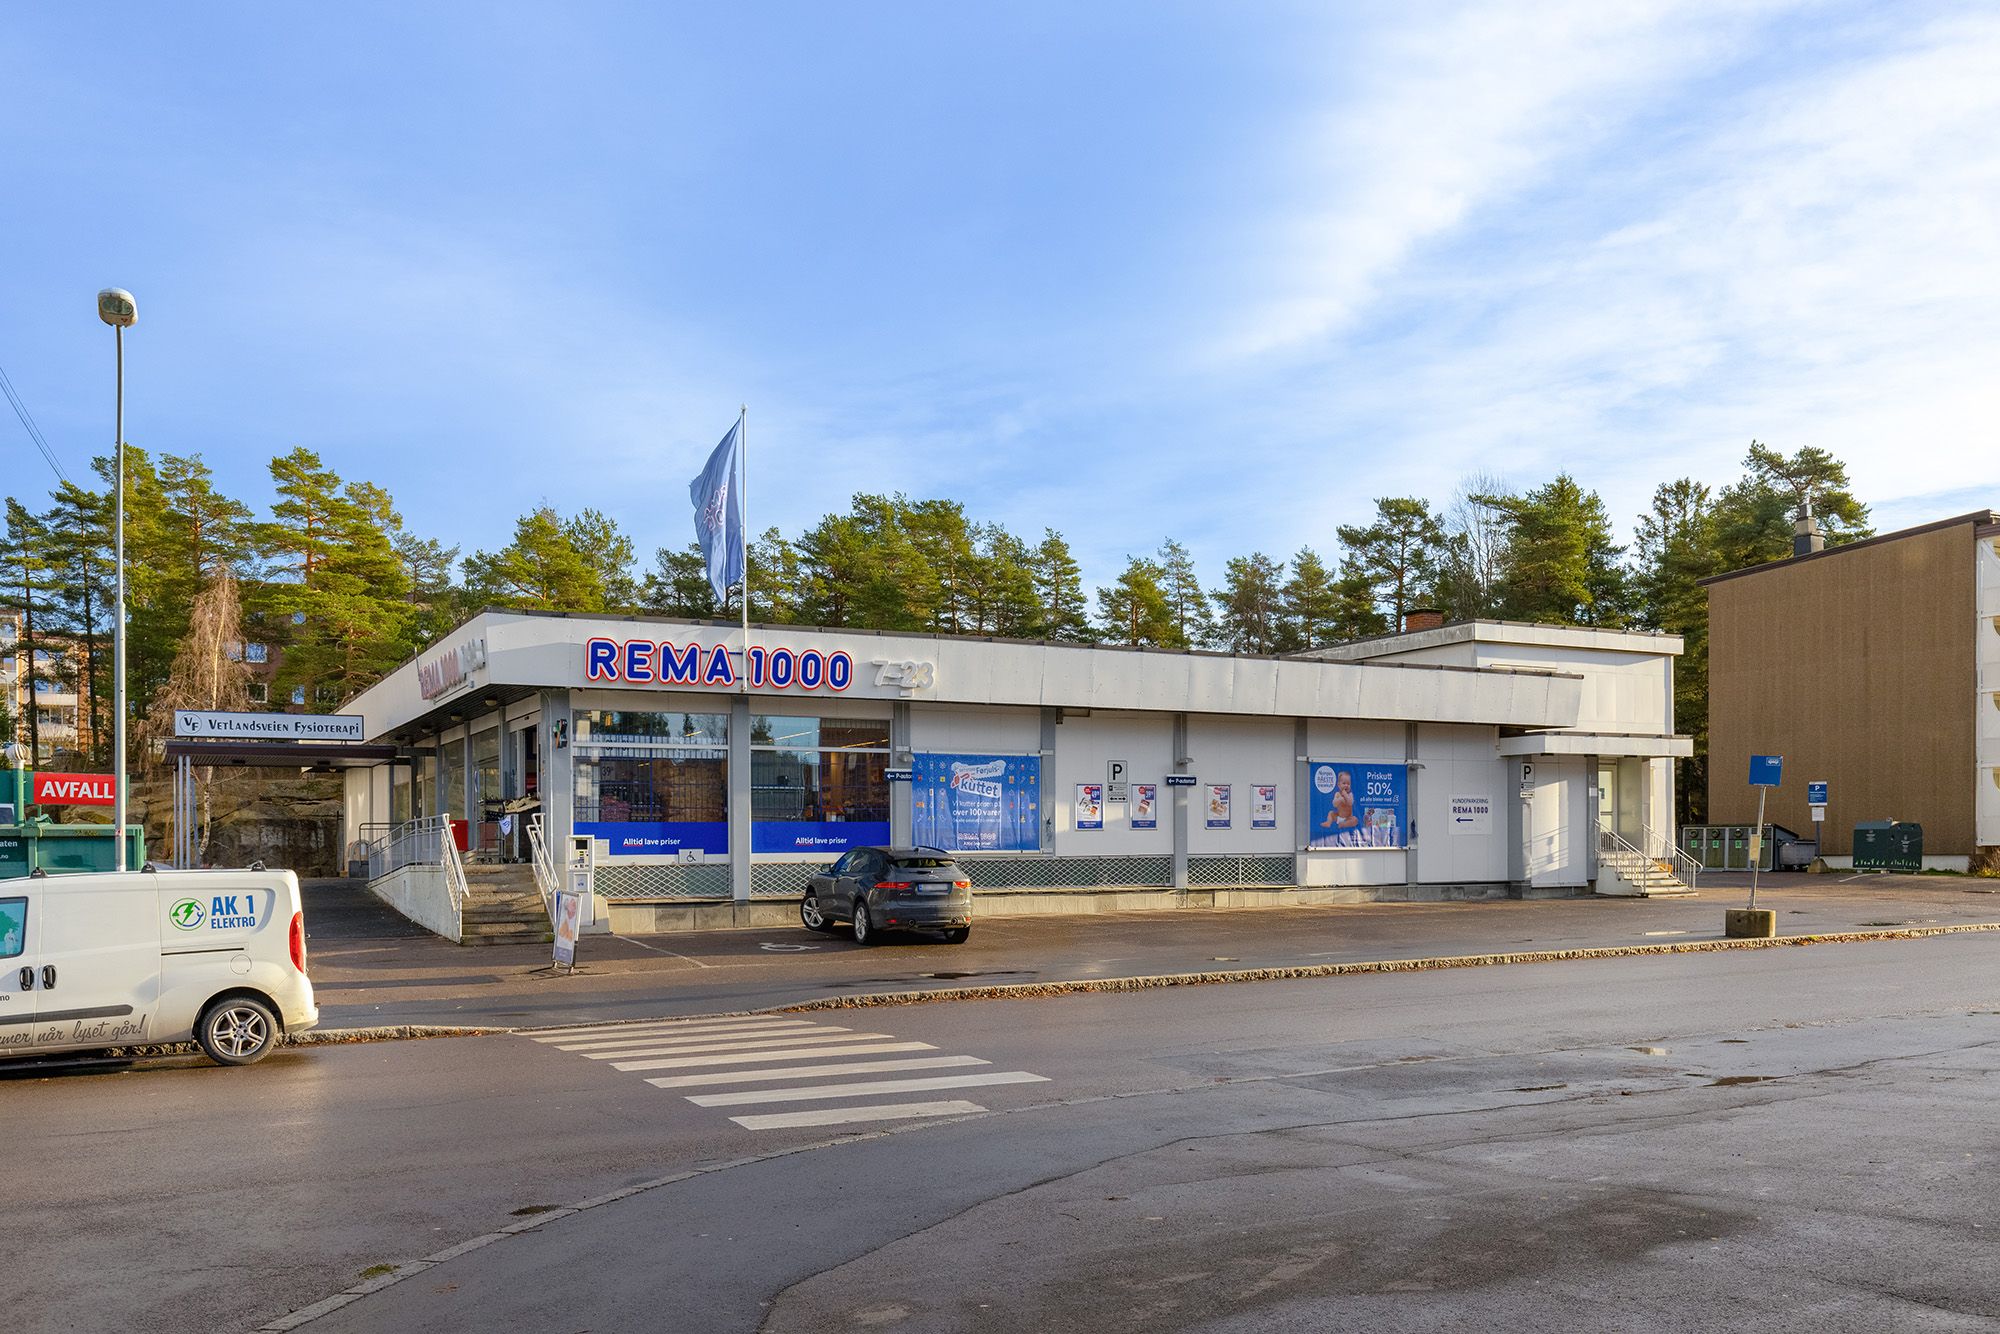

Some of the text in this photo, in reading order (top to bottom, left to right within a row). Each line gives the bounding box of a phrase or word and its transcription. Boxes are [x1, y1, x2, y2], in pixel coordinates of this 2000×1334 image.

[585, 637, 736, 685] REMA
[748, 645, 852, 692] 1000
[1112, 764, 1123, 780] P
[1366, 771, 1393, 780] Priskutt
[1524, 765, 1532, 780] P
[40, 781, 114, 799] AVFALL
[1367, 782, 1393, 795] 50%
[969, 808, 982, 816] 100
[1452, 806, 1488, 814] REMA 1000
[660, 838, 680, 847] priser
[829, 837, 847, 845] priser
[211, 895, 254, 916] AK 1
[211, 916, 256, 929] ELEKTRO
[37, 1026, 65, 1042] når
[72, 1020, 110, 1043] lyset
[111, 1014, 147, 1041] går!
